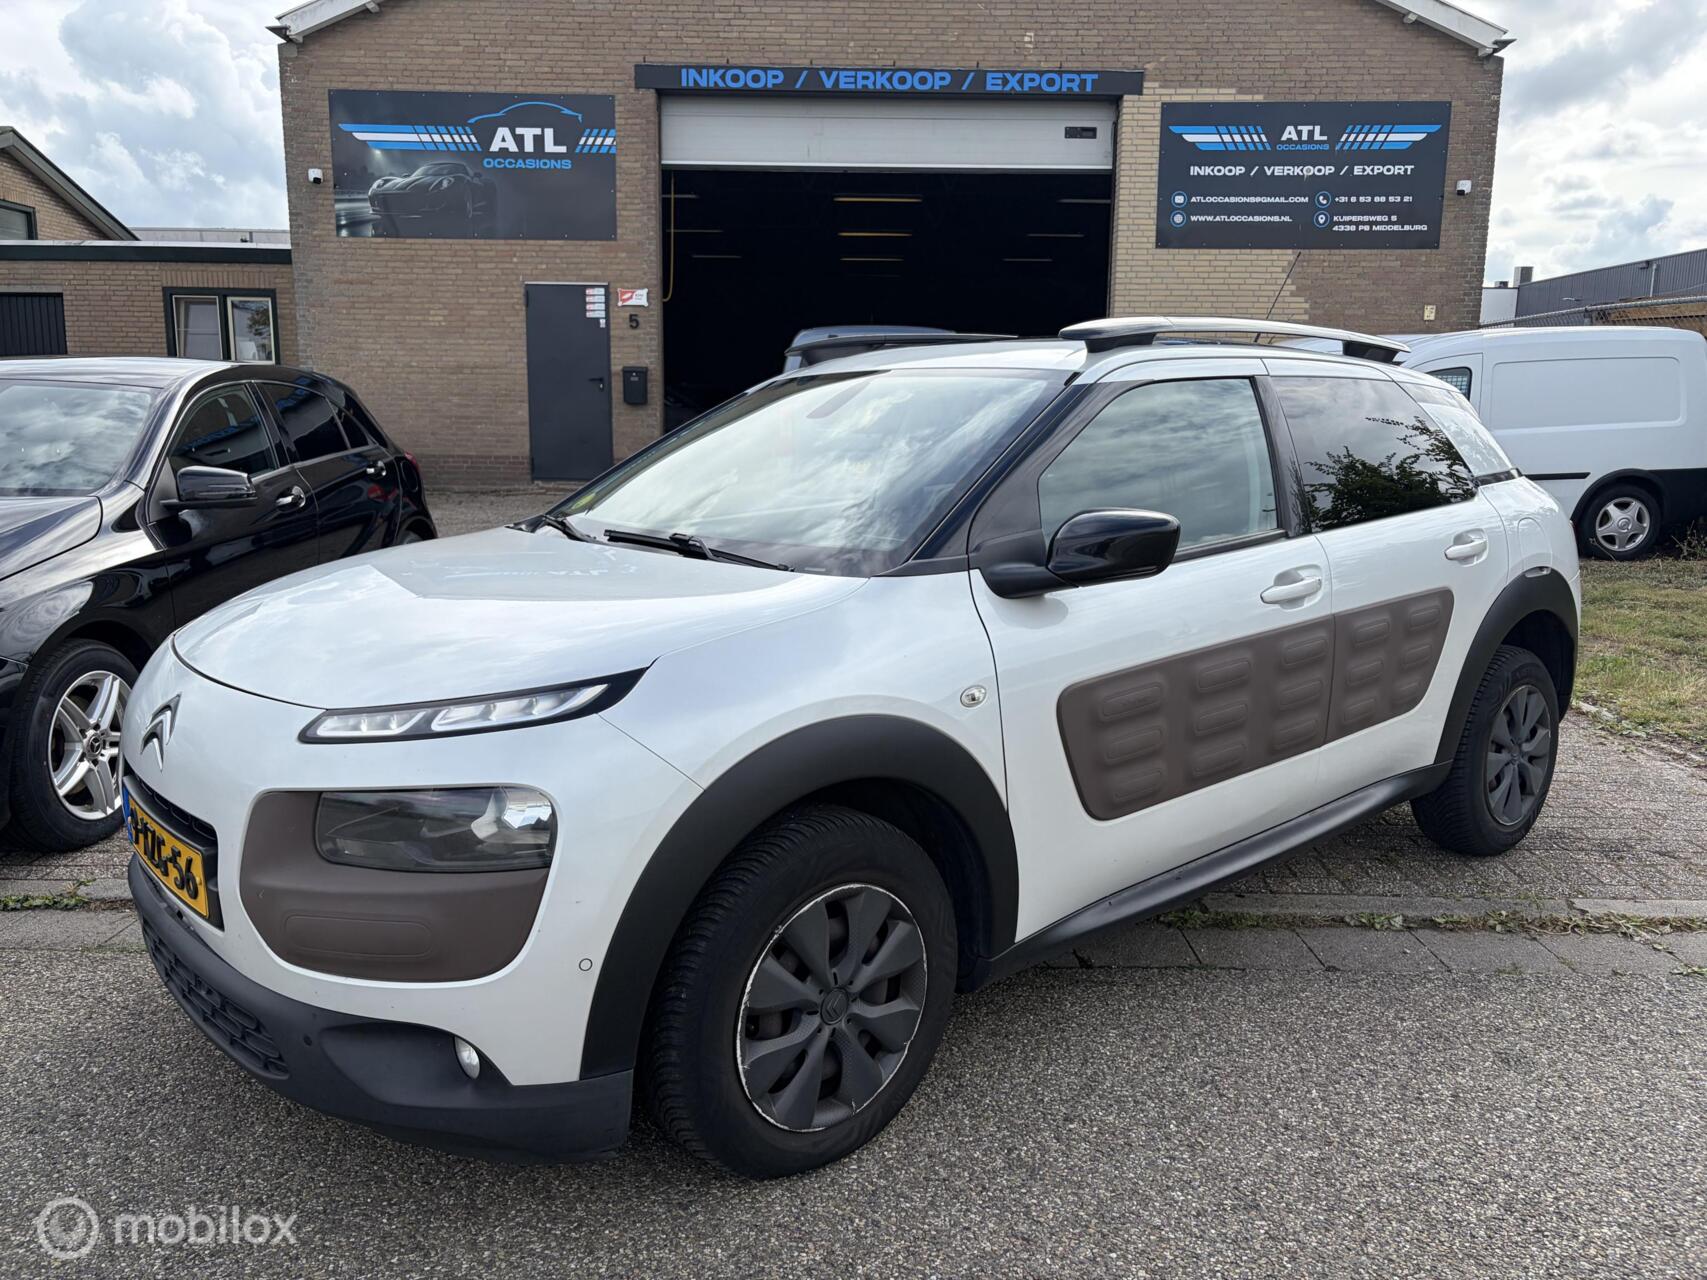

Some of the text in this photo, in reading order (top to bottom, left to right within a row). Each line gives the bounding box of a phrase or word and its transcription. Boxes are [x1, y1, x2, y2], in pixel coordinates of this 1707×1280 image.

[681, 68, 784, 89] INKOOP
[819, 71, 952, 90] VERKOOP
[985, 72, 1098, 92] EXPORT
[490, 127, 567, 153] ATL
[1280, 126, 1328, 141] ATL
[483, 158, 572, 169] OCCASIONS
[1190, 166, 1245, 176] INKOOP
[1264, 166, 1335, 176] VERKOOP
[1353, 165, 1414, 176] EXPORT
[629, 314, 639, 328] 5
